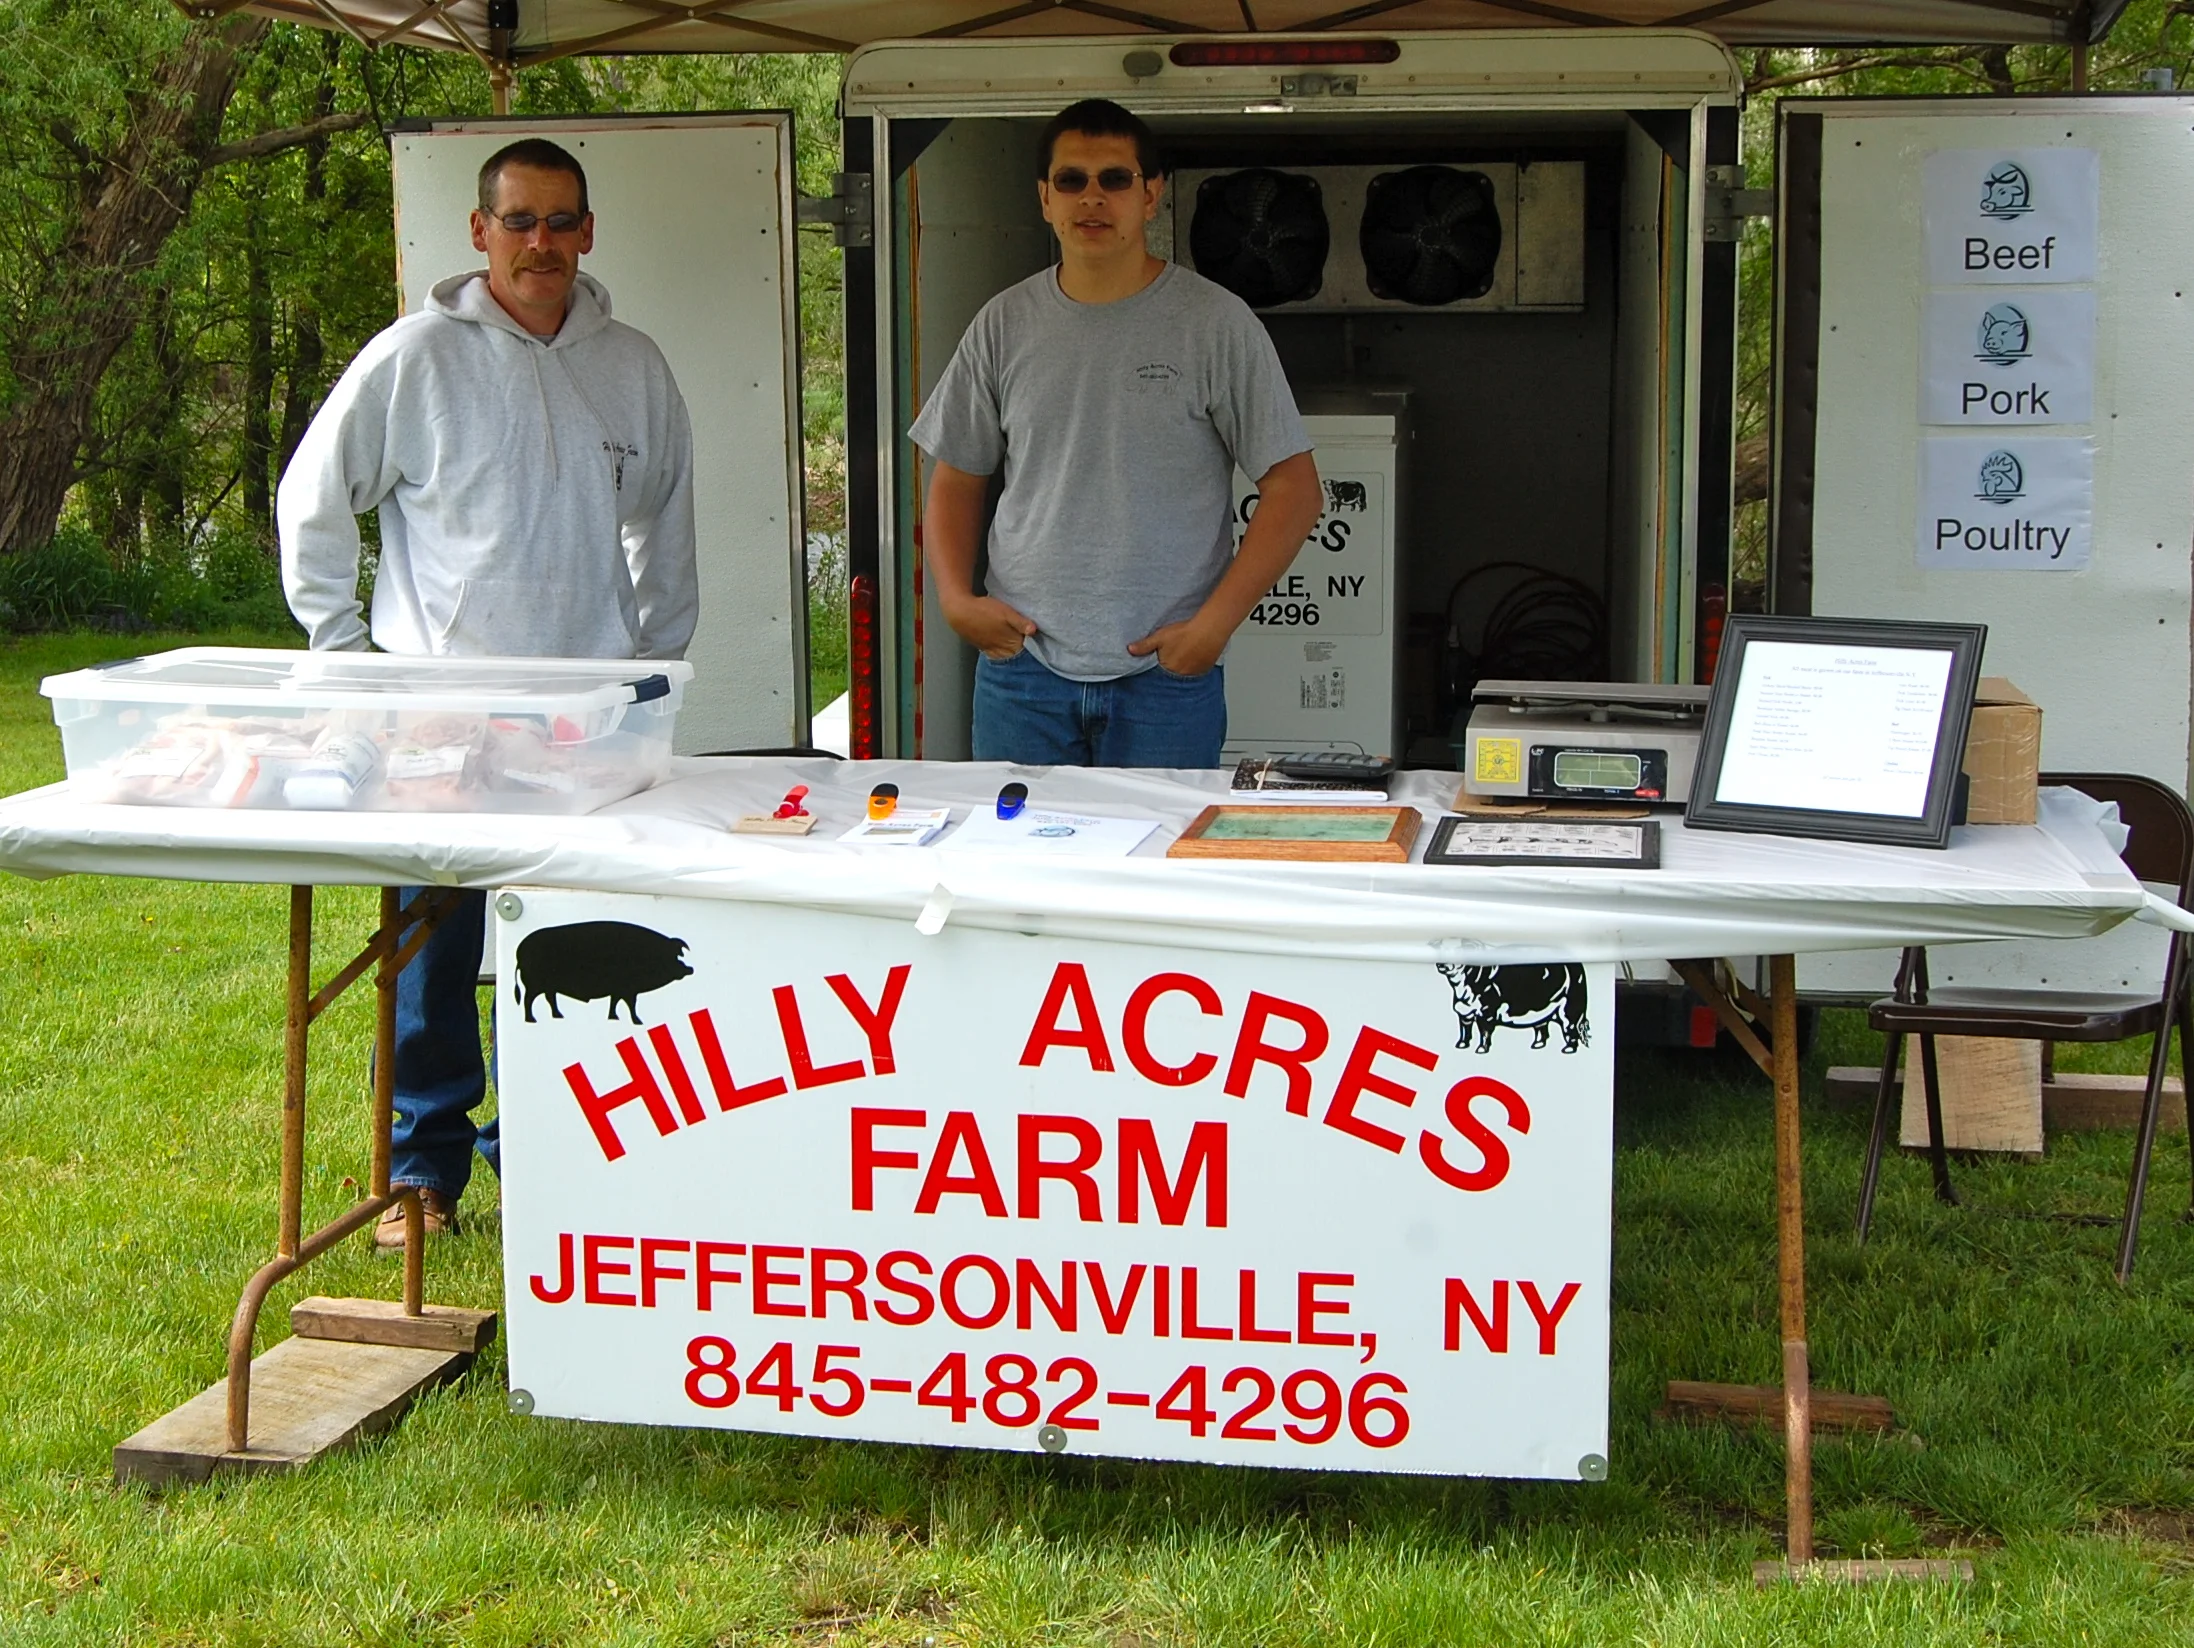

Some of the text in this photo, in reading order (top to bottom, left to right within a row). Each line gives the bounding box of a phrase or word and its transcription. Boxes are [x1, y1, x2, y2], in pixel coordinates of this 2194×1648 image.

[1965, 236, 2056, 270] Beef
[1963, 383, 2050, 415] Pork
[1936, 518, 2071, 560] Poultry
[1327, 575, 1365, 598] NY
[562, 962, 1531, 1192] HILLY ACRES
[851, 1107, 1228, 1228] FARM
[529, 1233, 1582, 1364] JEFFERSONVILLE, NY
[684, 1336, 1410, 1448] 845-482-4296
